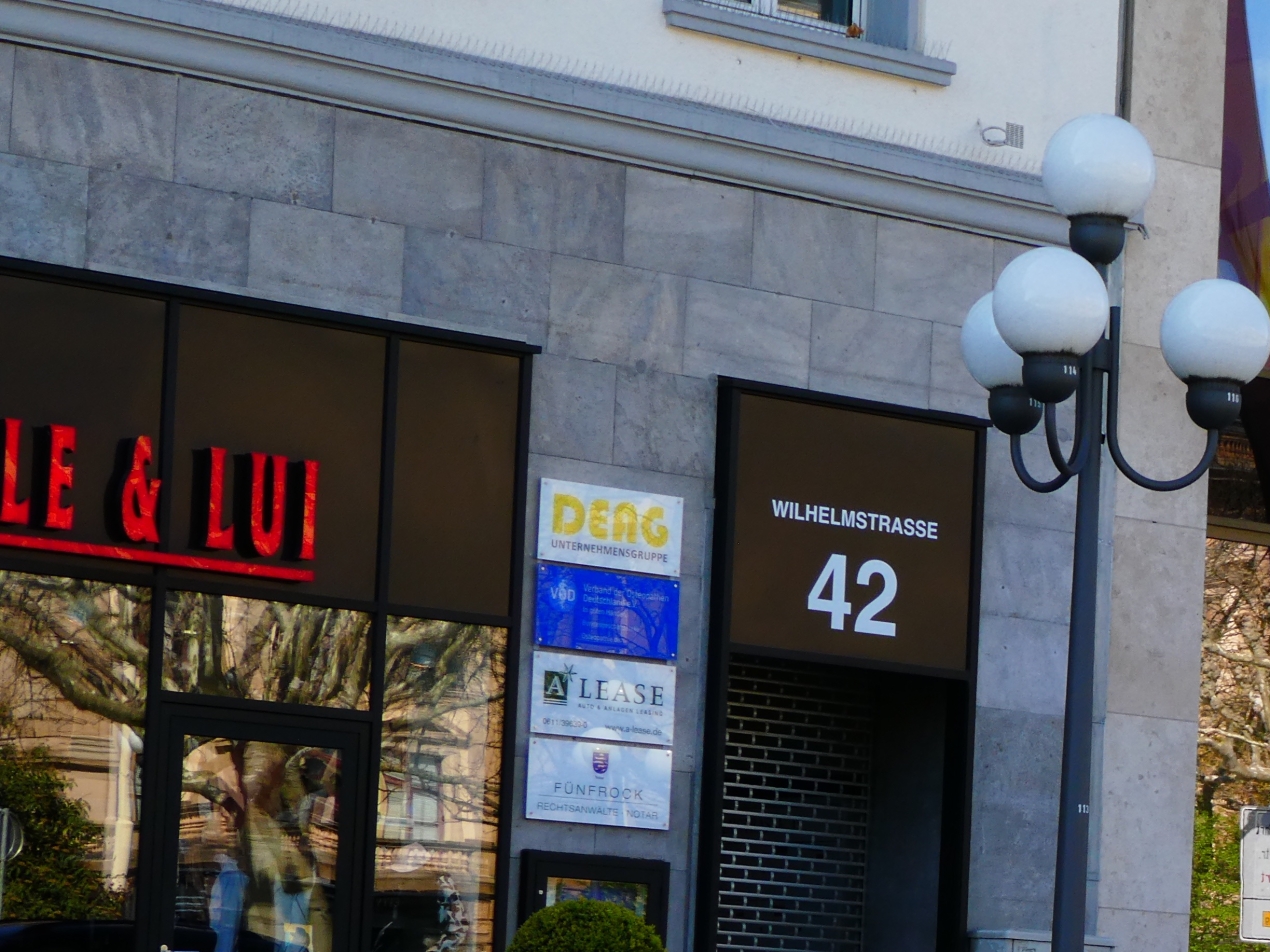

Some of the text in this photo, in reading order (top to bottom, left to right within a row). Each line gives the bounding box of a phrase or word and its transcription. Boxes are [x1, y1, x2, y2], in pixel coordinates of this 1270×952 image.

[122, 435, 161, 543] &
[206, 446, 320, 560] LUI
[552, 493, 669, 548] DEAG
[772, 499, 939, 540] WILHELMSTRASSE
[551, 539, 668, 563] UNTERNEHMENSGRUPPE
[808, 553, 898, 637] 42
[579, 677, 664, 707] LEASE
[636, 709, 663, 717] LEASING
[604, 723, 663, 736] www.a-lease.de
[554, 782, 644, 801] FÜNFROCK
[627, 809, 659, 820] NOTAR
